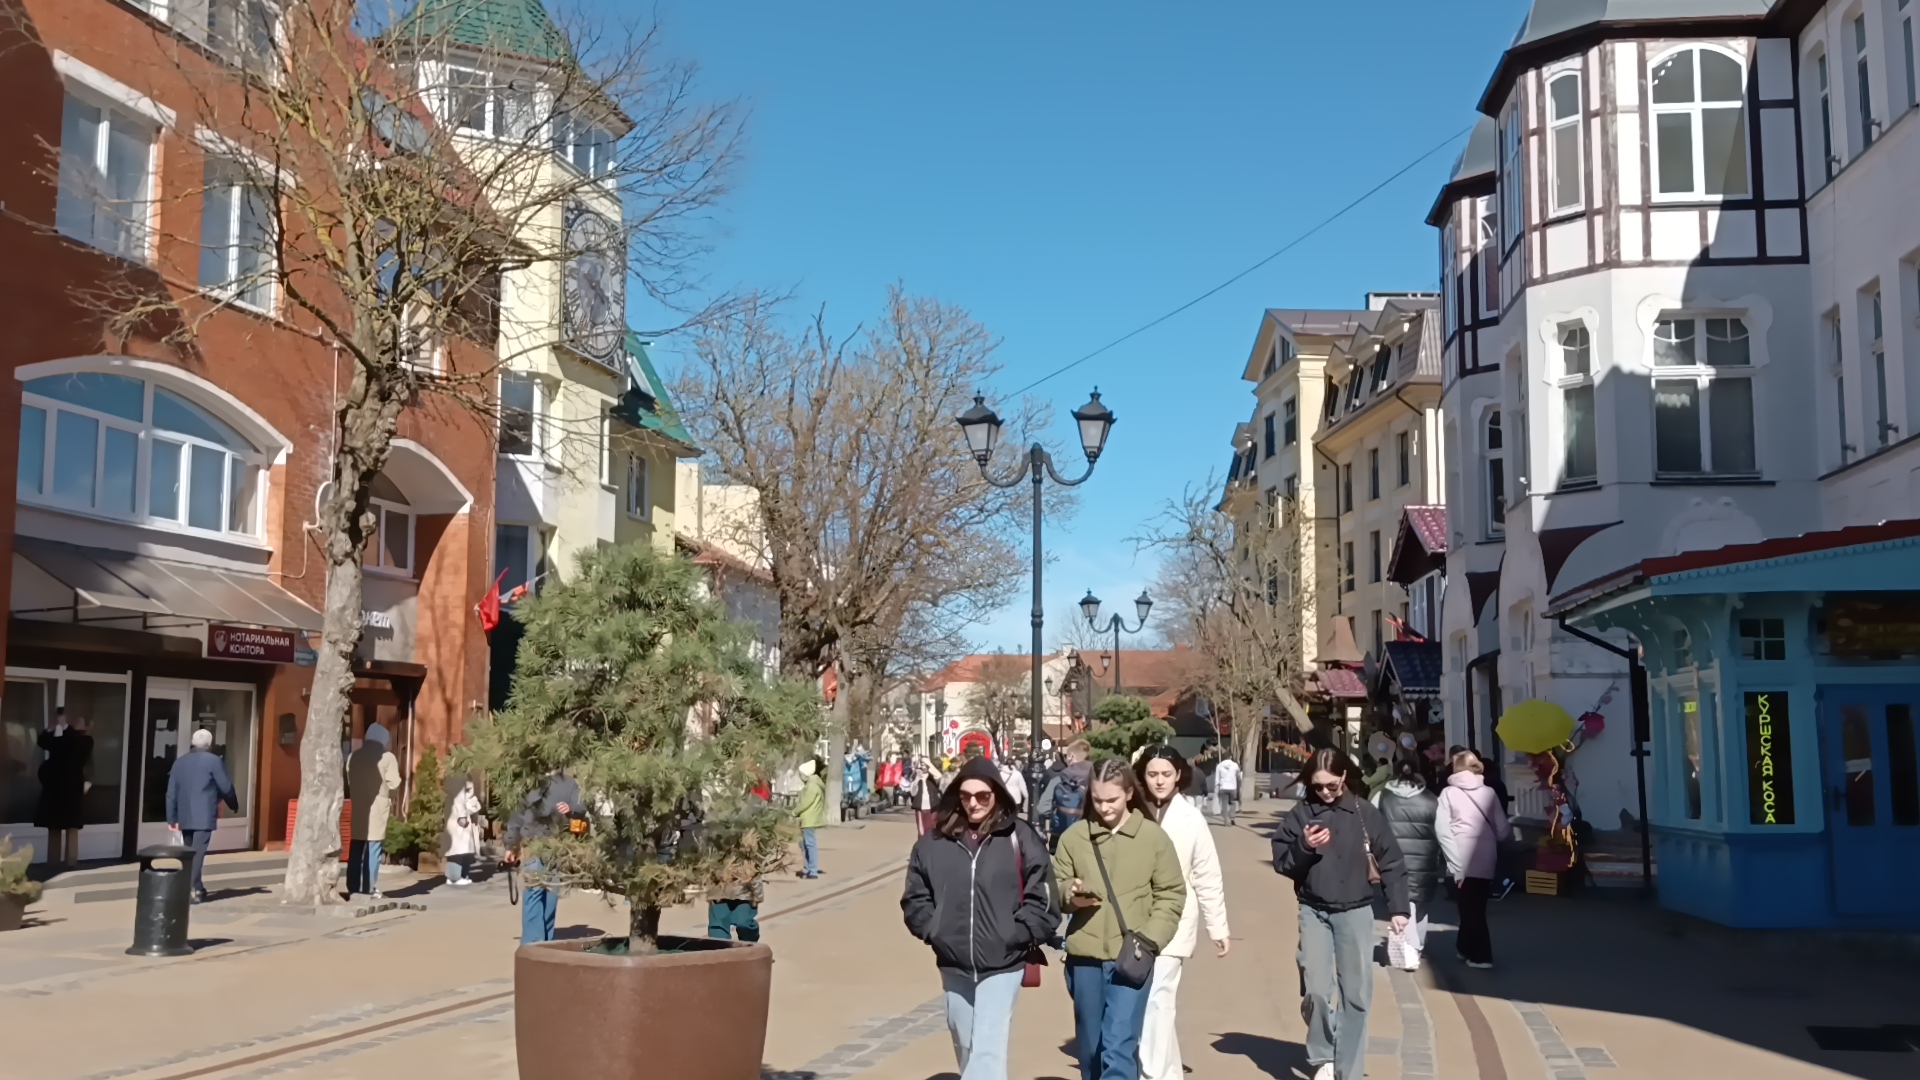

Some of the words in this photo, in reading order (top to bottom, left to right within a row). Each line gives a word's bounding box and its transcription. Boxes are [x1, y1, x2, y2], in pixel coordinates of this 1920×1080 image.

[230, 632, 290, 647] НОТАРИАЛЬНАЯ
[230, 644, 265, 656] КОНТОРА
[1757, 694, 1774, 777] КУРШСКАЯ
[1762, 780, 1776, 824] КОСА
